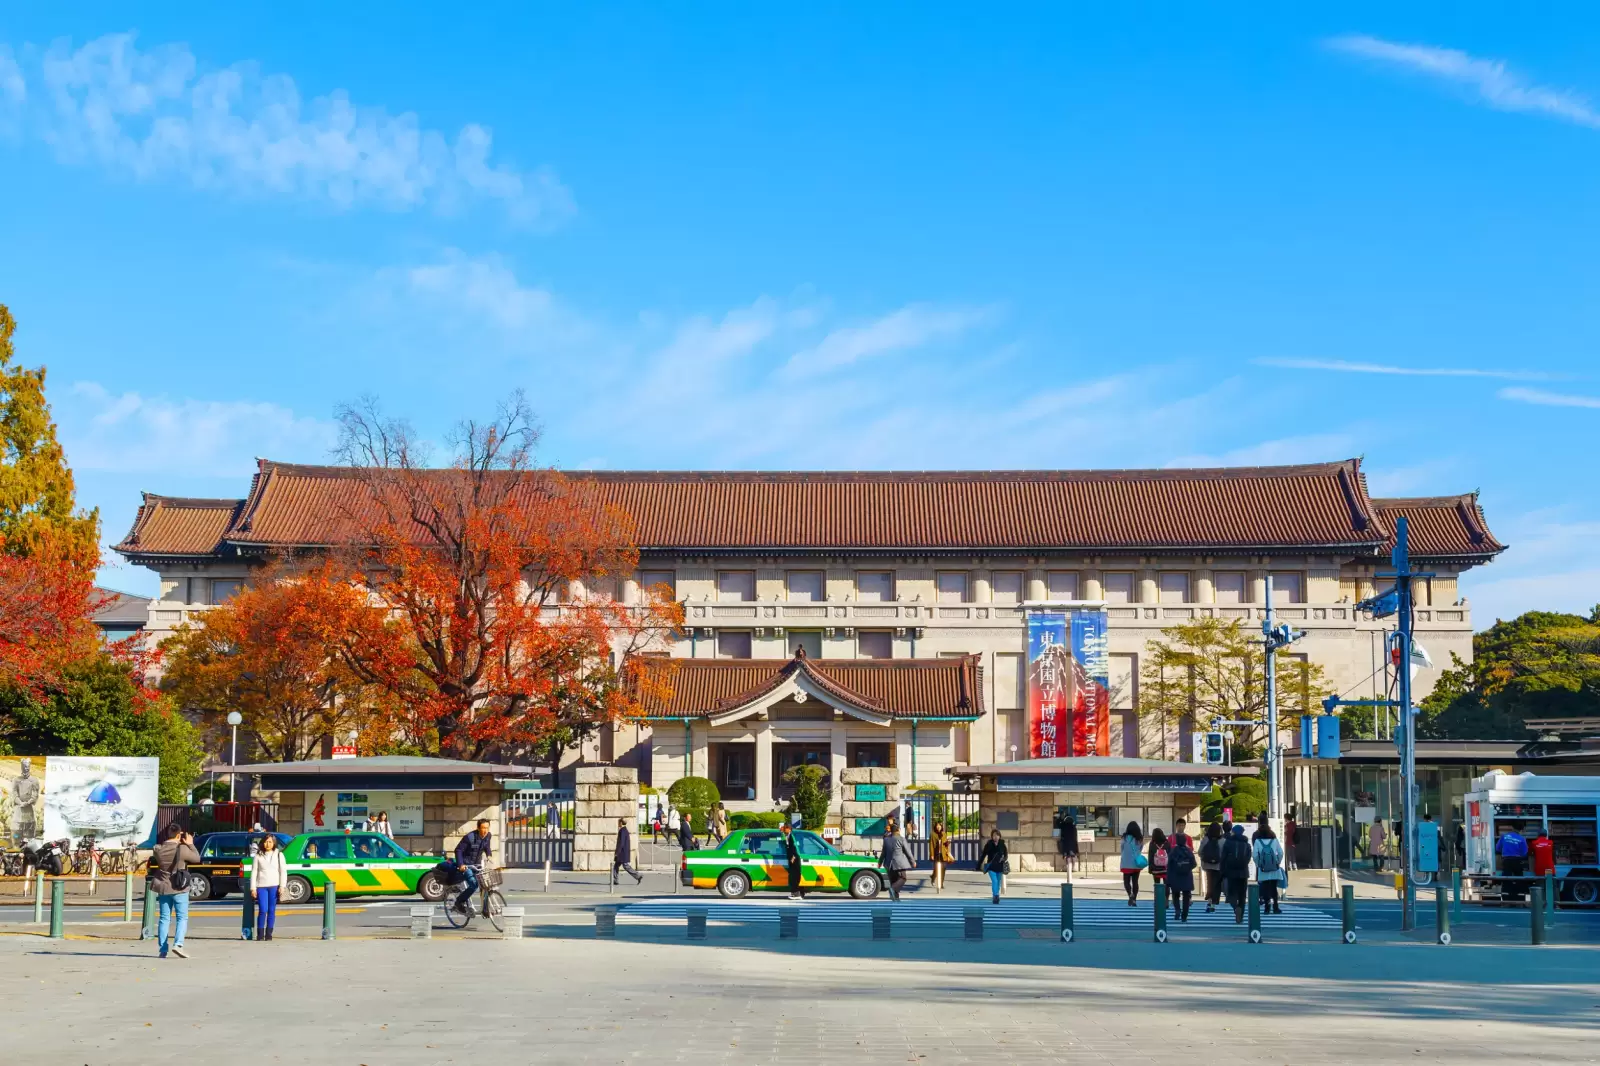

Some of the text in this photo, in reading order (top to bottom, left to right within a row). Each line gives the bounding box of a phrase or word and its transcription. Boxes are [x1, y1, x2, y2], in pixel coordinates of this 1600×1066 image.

[1084, 625, 1095, 666] TOKYO
[1039, 631, 1057, 758] 東京国立博物館
[1085, 668, 1096, 729] NATIONAL
